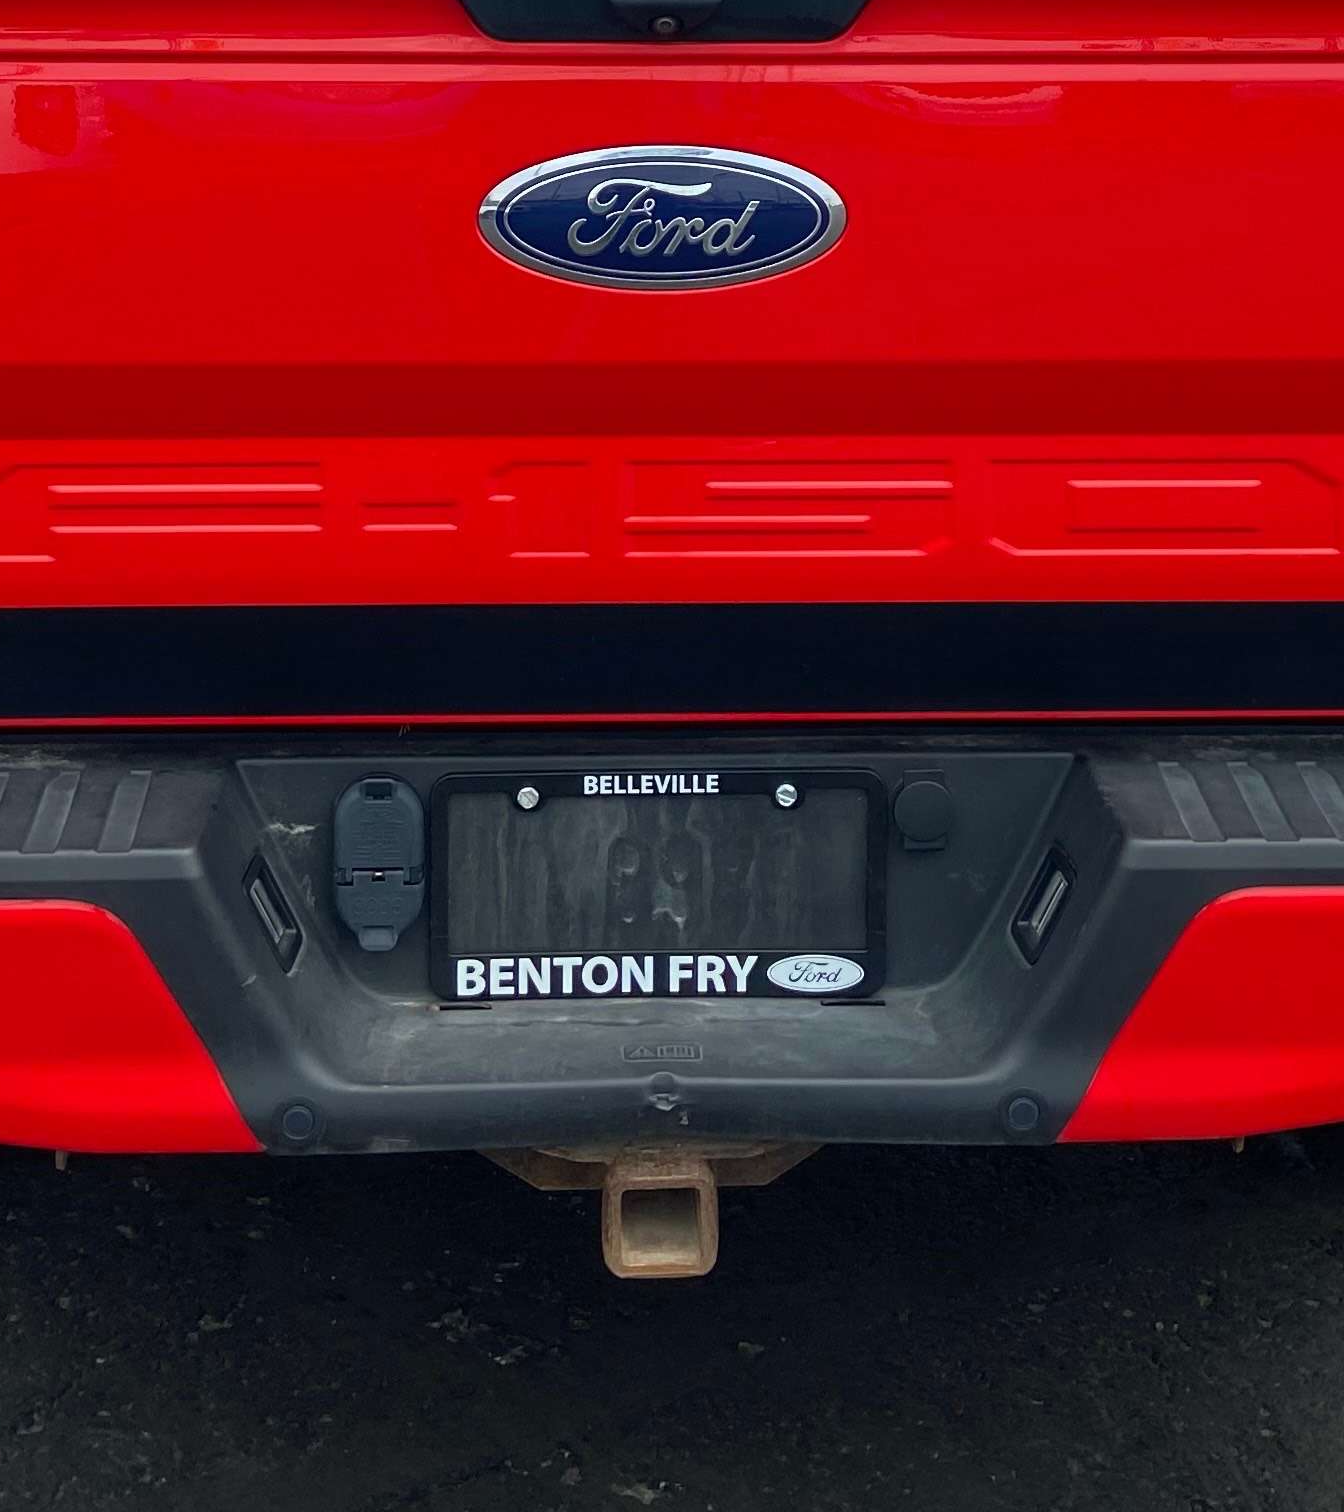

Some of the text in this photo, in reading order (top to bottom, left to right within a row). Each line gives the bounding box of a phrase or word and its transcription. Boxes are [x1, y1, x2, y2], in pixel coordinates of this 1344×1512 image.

[566, 177, 760, 257] Ford
[583, 774, 720, 795] BELLEVILLE
[457, 954, 843, 997] BENTON FRY Ford
